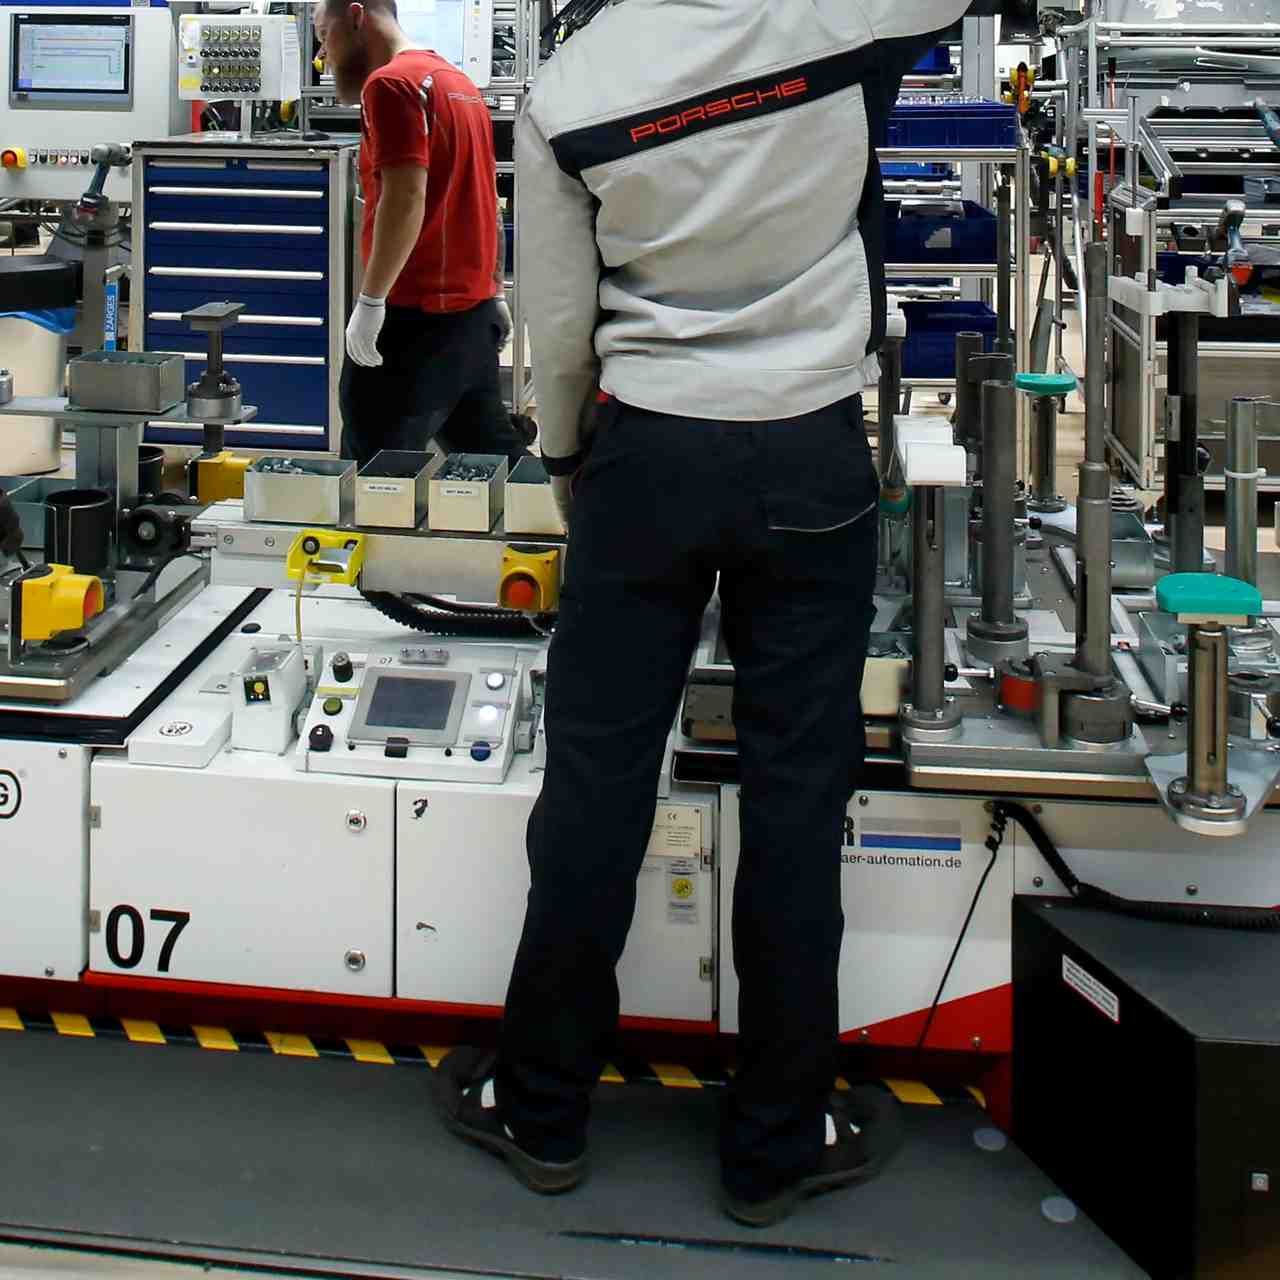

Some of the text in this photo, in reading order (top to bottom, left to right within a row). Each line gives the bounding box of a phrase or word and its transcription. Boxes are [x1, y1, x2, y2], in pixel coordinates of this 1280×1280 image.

[630, 76, 808, 144] PORSCHE
[840, 854, 962, 869] aer-automation.de
[105, 904, 190, 972] 07
